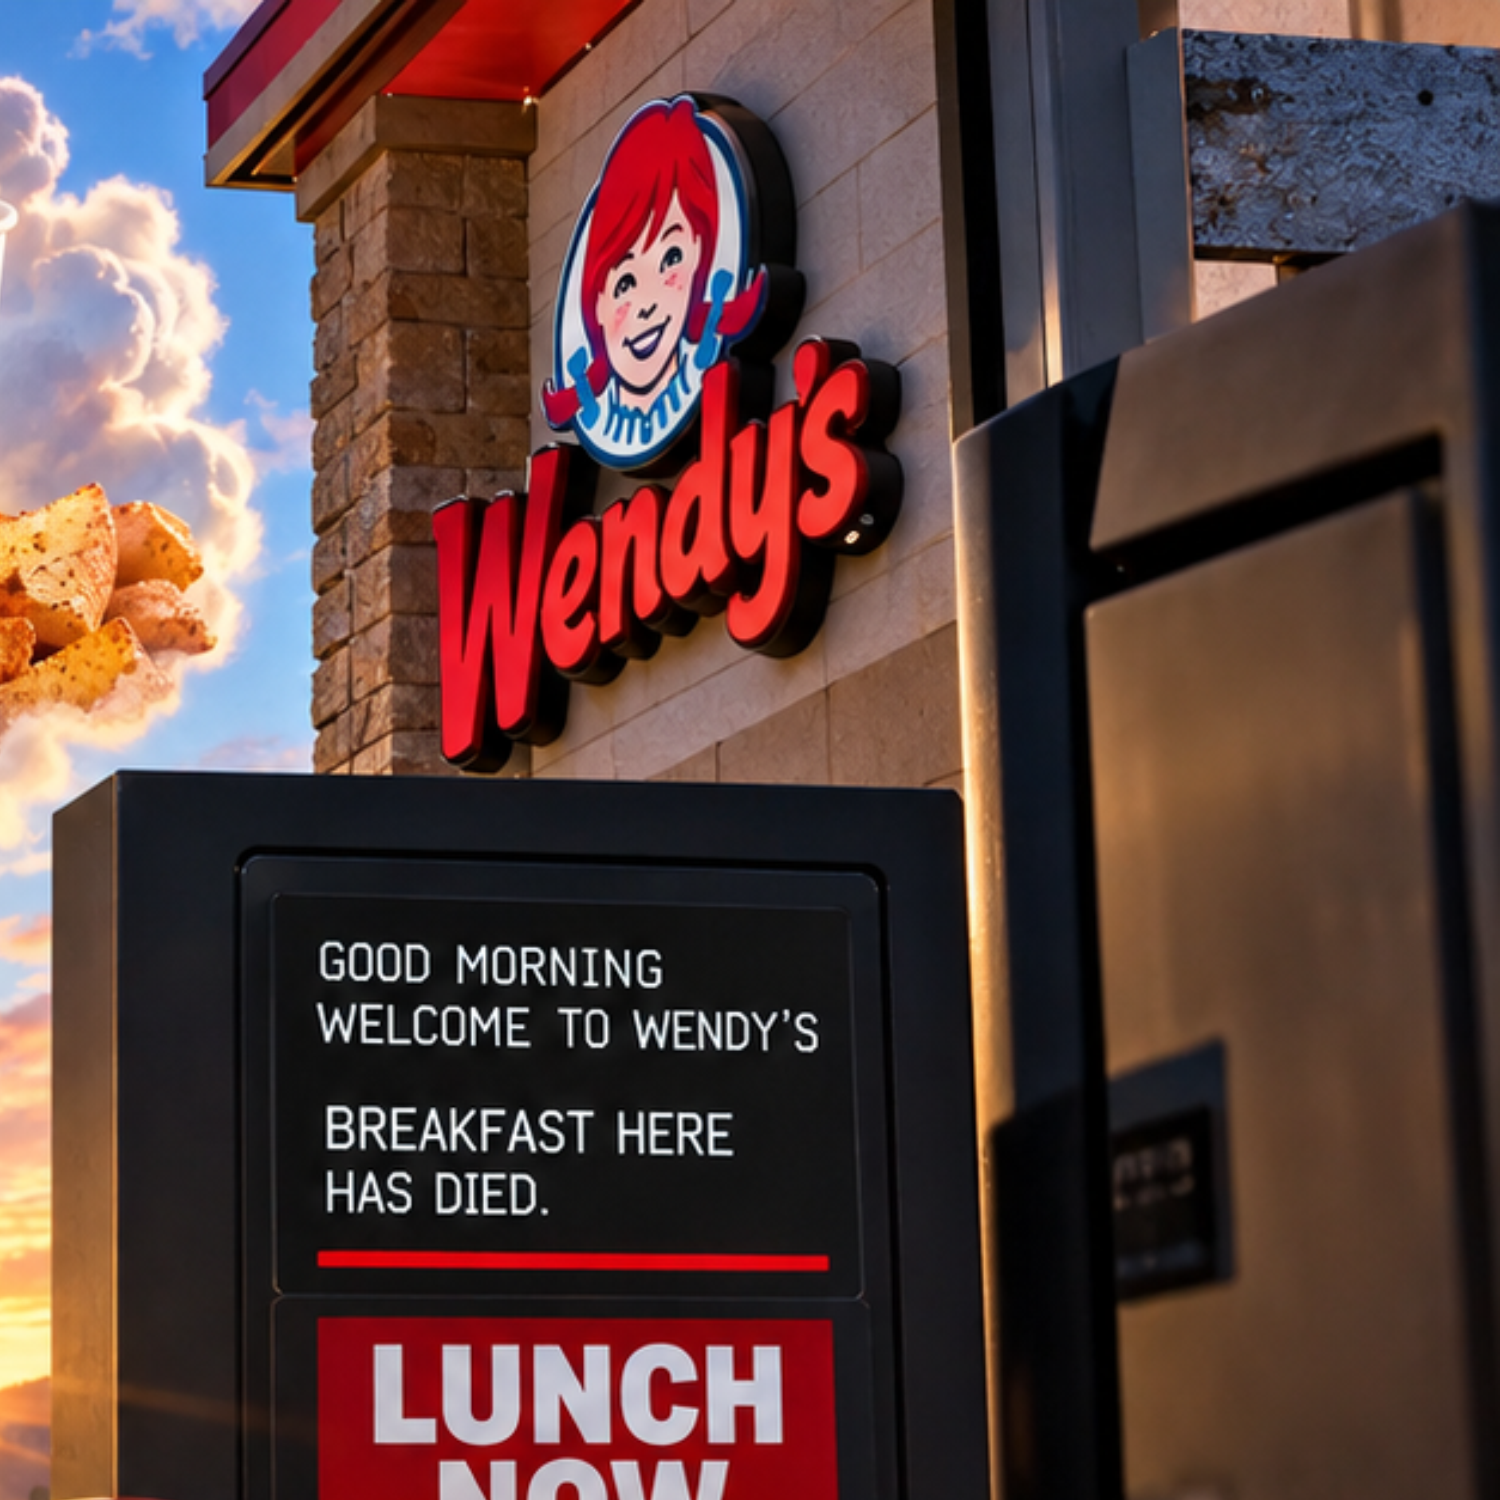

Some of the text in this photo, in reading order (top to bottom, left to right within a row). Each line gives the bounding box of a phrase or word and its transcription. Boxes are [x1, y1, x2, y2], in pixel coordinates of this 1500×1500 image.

[432, 335, 870, 760] Wendy's
[318, 941, 663, 990] GOOD MORNING
[316, 1002, 820, 1054] WELCOME TO WENDY'S
[325, 1105, 735, 1157] BREAKFAST HERE
[325, 1170, 550, 1217] HAS DIED.
[373, 1343, 784, 1446] LUNCH
